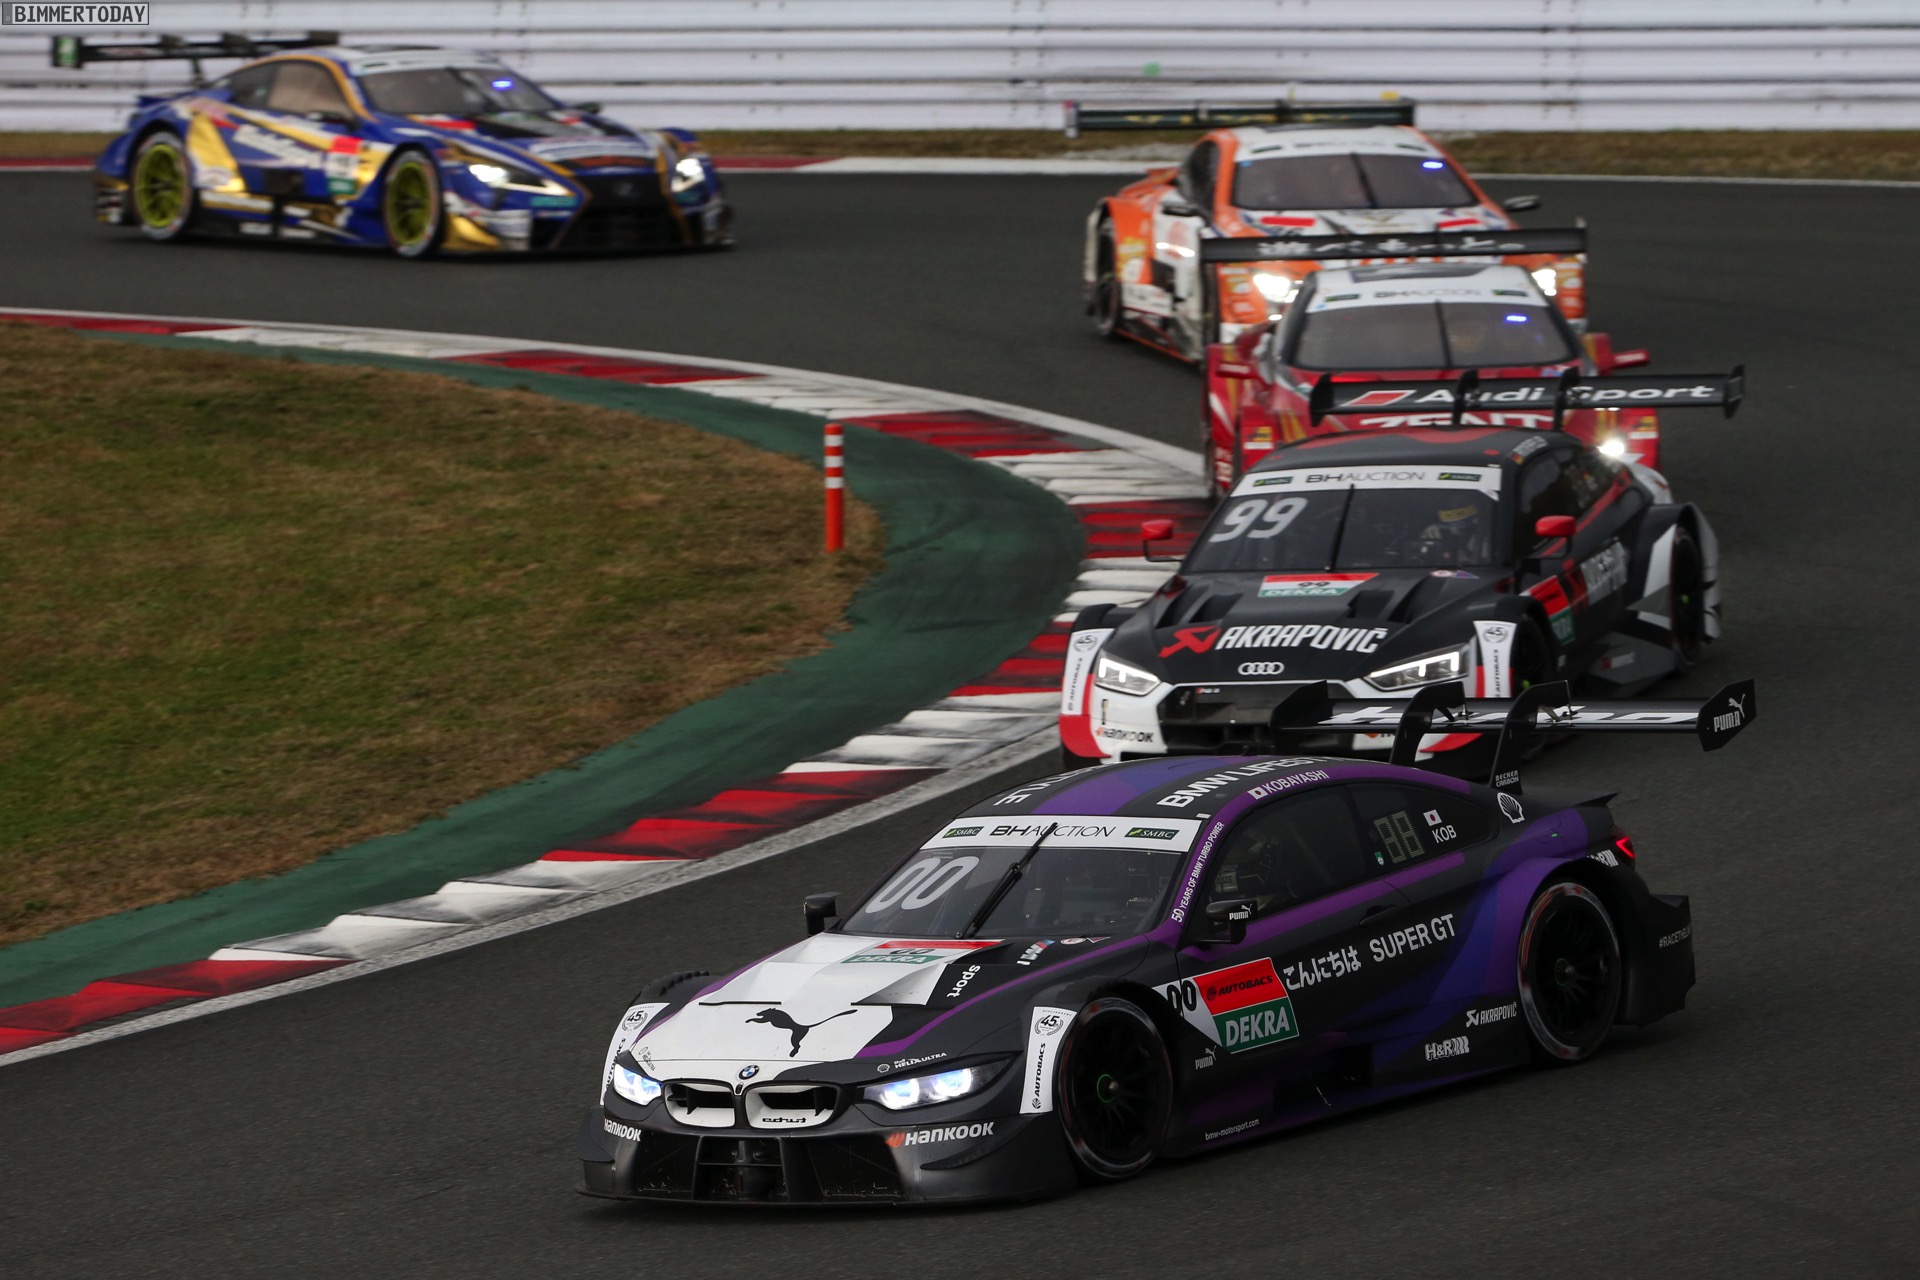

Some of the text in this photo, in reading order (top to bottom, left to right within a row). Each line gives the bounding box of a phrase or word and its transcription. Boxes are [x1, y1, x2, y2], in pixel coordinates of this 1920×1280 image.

[1208, 497, 1308, 543] 99
[1713, 710, 1741, 733] PUMA
[1262, 770, 1330, 793] KOBAYASHI
[1495, 770, 1519, 781] BECKER
[1495, 776, 1520, 788] CARBON
[1156, 773, 1240, 808] BMW
[953, 828, 980, 836] SMBC
[1141, 829, 1175, 839] SMBC
[1431, 824, 1457, 844] KOB
[1171, 821, 1225, 923] 50 YEARS OF BMW TURBO POWER
[865, 856, 980, 914] 00
[1229, 911, 1249, 920] PUMA
[854, 955, 928, 963] DEKRA
[1283, 913, 1456, 991] こんにちは SUPER GT
[946, 964, 981, 998] sport
[1218, 975, 1273, 997] AUTOBACS
[1166, 979, 1198, 1014] 00
[627, 1010, 644, 1023] 45
[1040, 1014, 1060, 1027] 45
[1225, 1006, 1291, 1048] DEKRA
[921, 1052, 948, 1063] ULTRA
[1425, 1037, 1460, 1062] H&R
[1034, 1042, 1046, 1098] AUTOBACS
[1195, 1056, 1213, 1070] PUMA
[1205, 1118, 1260, 1141] bmw-motorsport.com
